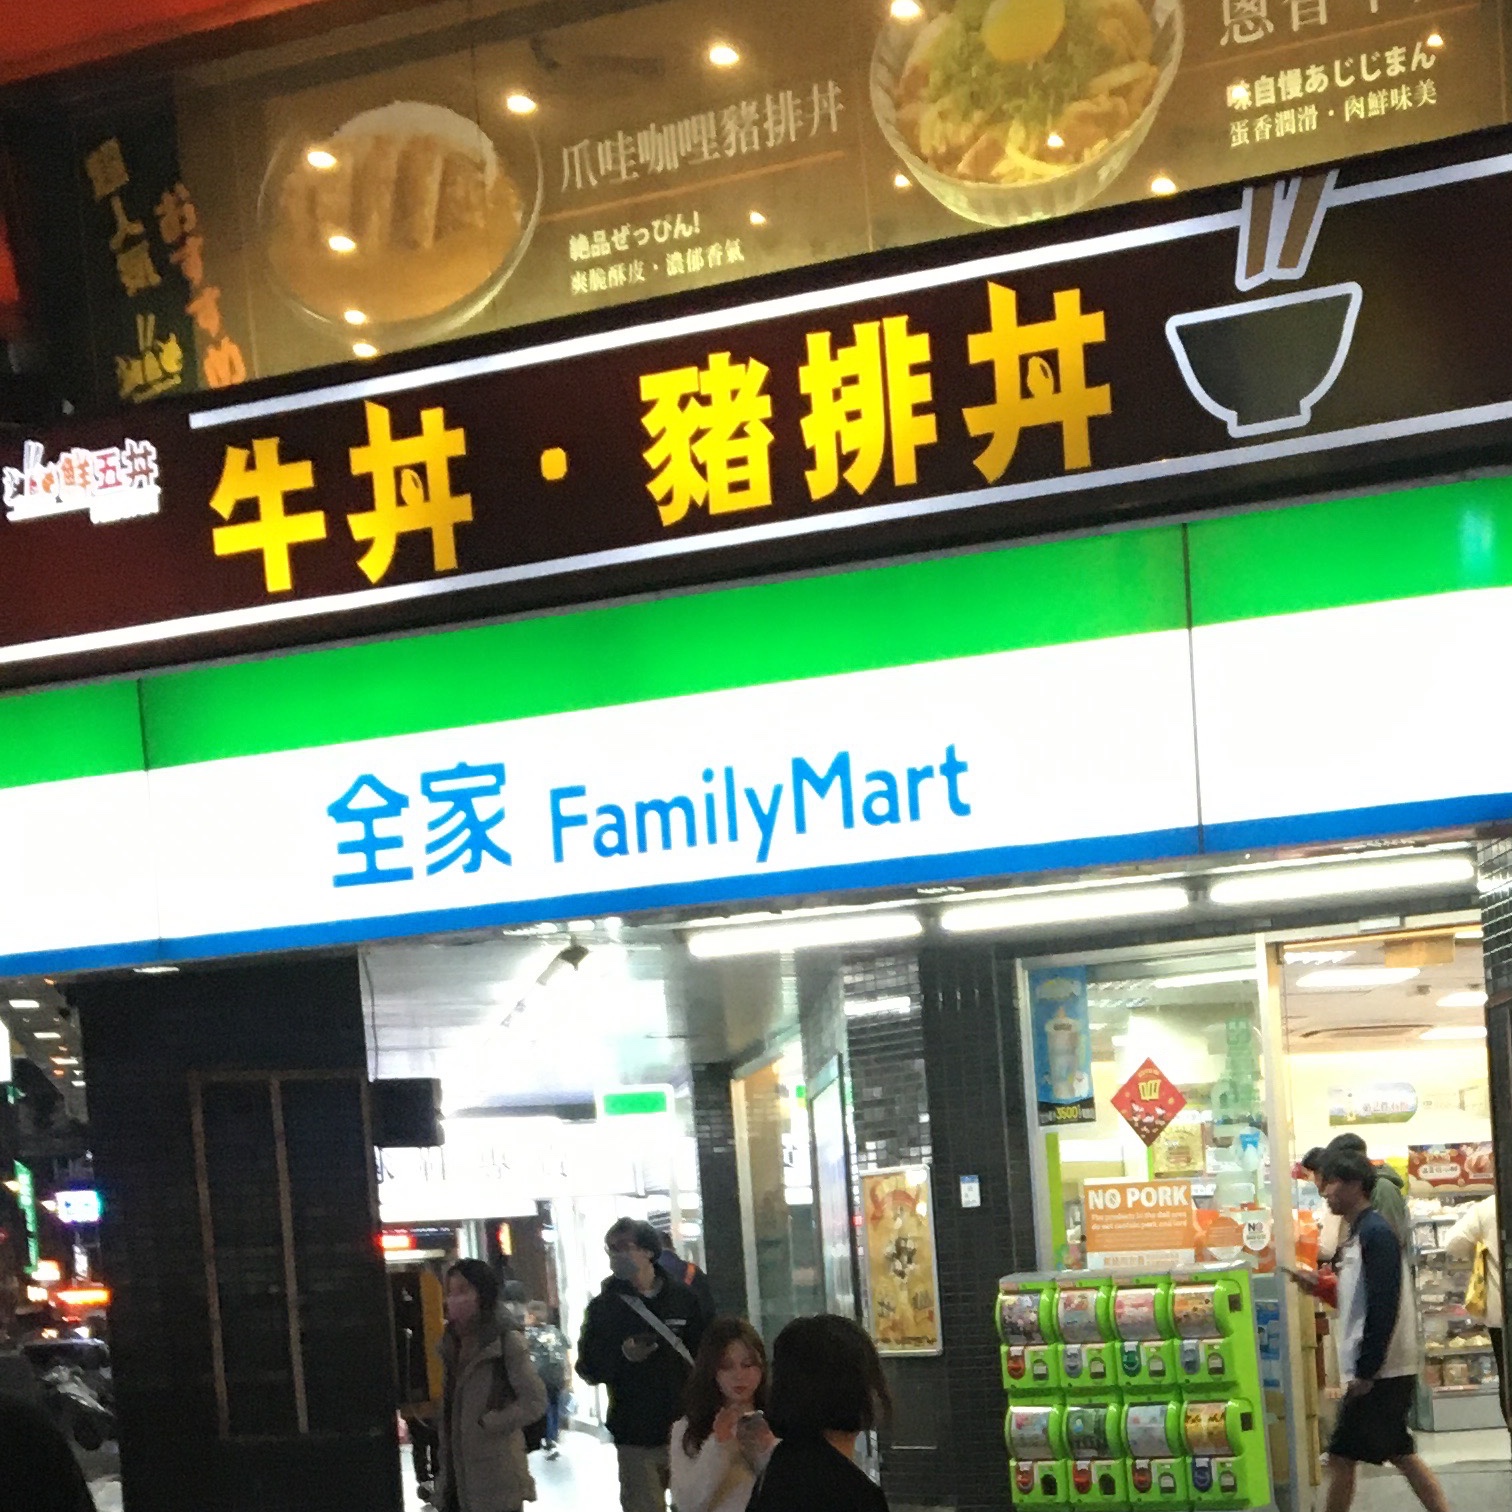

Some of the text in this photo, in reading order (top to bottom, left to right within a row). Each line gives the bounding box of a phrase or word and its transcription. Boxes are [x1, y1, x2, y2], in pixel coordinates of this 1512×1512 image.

[327, 743, 971, 888] 全家 FamilyMart
[1088, 1184, 1188, 1210] NO PORK
